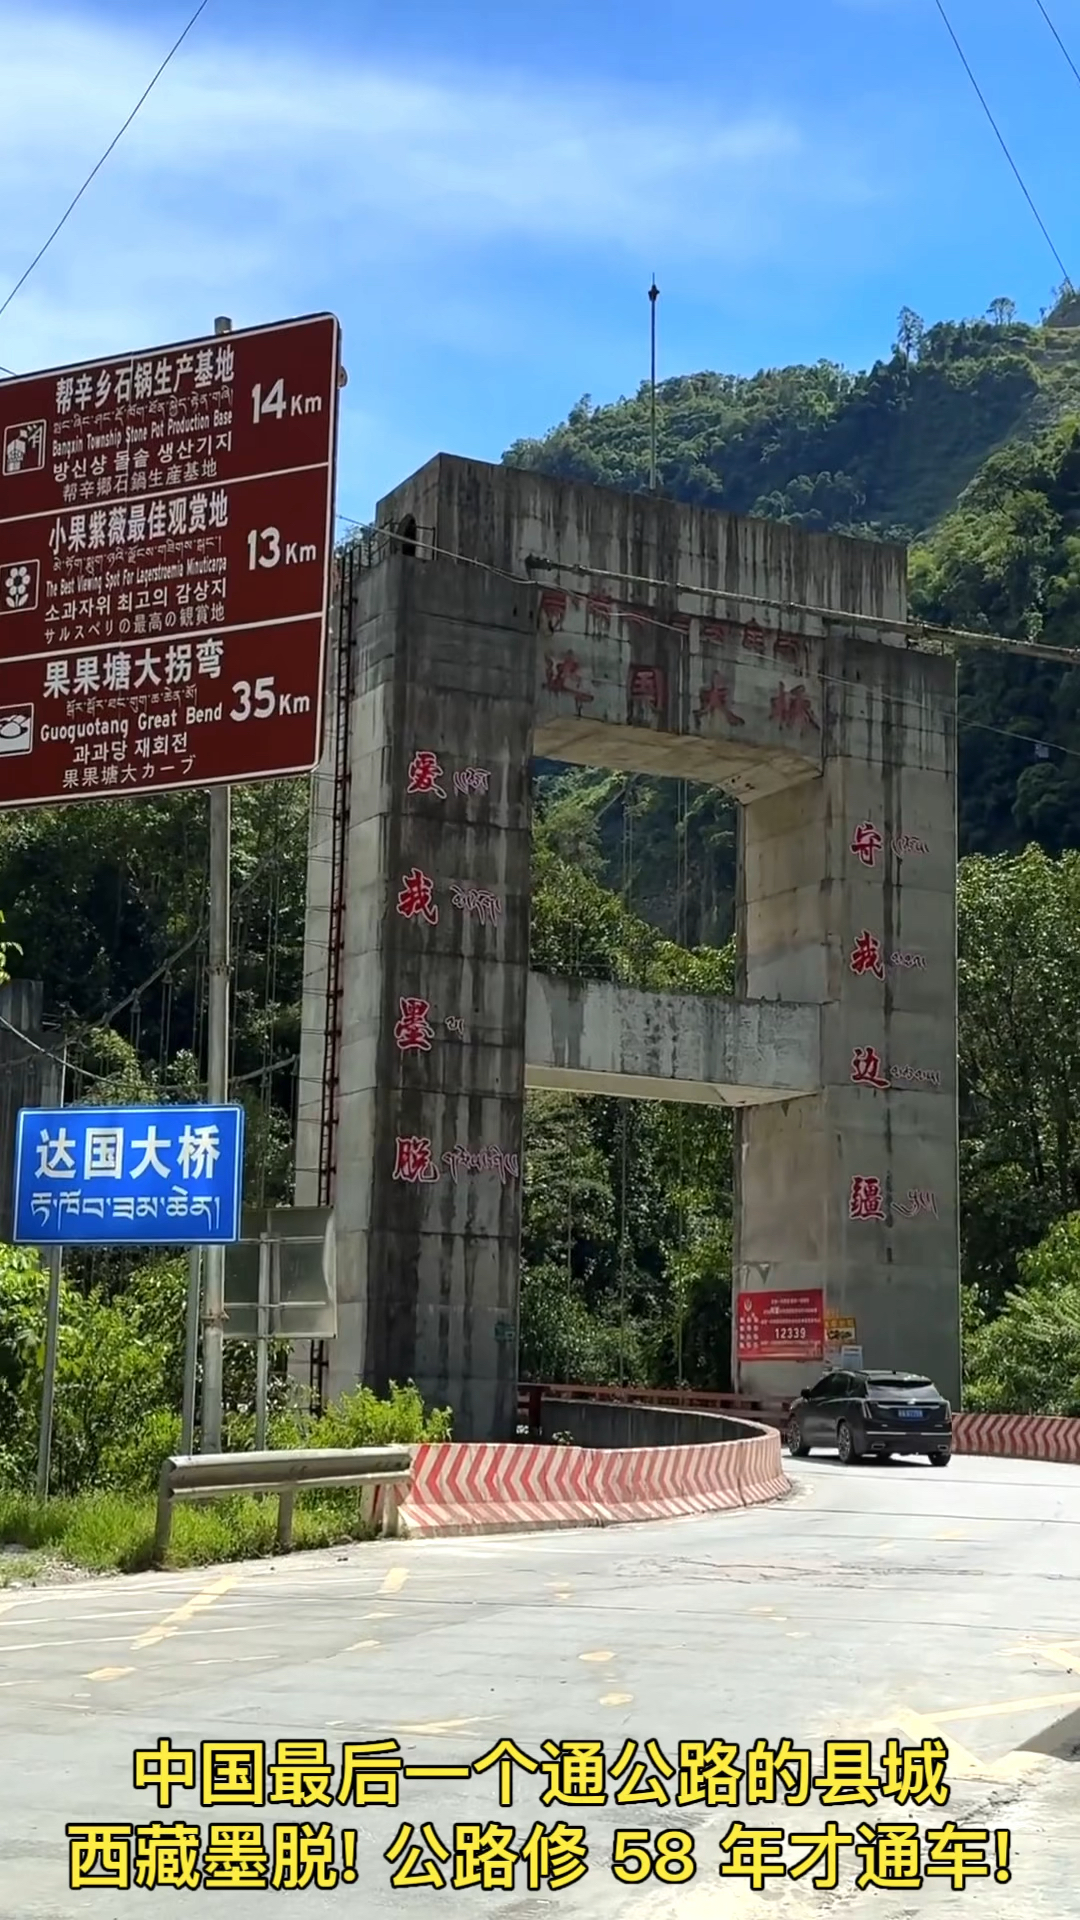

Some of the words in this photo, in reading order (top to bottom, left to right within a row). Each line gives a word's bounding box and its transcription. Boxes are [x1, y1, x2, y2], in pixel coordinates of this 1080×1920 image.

[56, 344, 234, 415] 帮辛乡石锅生产基地
[87, 427, 121, 450] Township
[125, 425, 147, 447] Stone
[151, 420, 164, 440] Pot
[168, 412, 209, 436] Production
[213, 409, 232, 427] Base
[157, 431, 232, 462] 생산기지
[48, 488, 229, 555] 小果紫薇最佳观赏地
[46, 579, 58, 597] The
[60, 576, 74, 595] Best
[77, 571, 102, 594] Viewing
[105, 569, 121, 590] Spot
[123, 566, 134, 585] For
[136, 560, 184, 586] Lagerstroemia
[44, 591, 111, 623] 소과자위
[117, 586, 168, 613] 최고의
[176, 577, 227, 604] 감상지
[43, 638, 224, 699] 果果塘大拐弯
[40, 716, 128, 743] Guoguotang
[138, 708, 177, 731] Great
[186, 703, 222, 725] Bend
[73, 739, 128, 765] 과과당
[134, 731, 188, 758] 재회전
[62, 755, 197, 789] 果果塘大カーブ
[849, 820, 891, 1221] 守我边疆
[34, 1124, 221, 1180] 达国大桥
[775, 1327, 806, 1339] 12339
